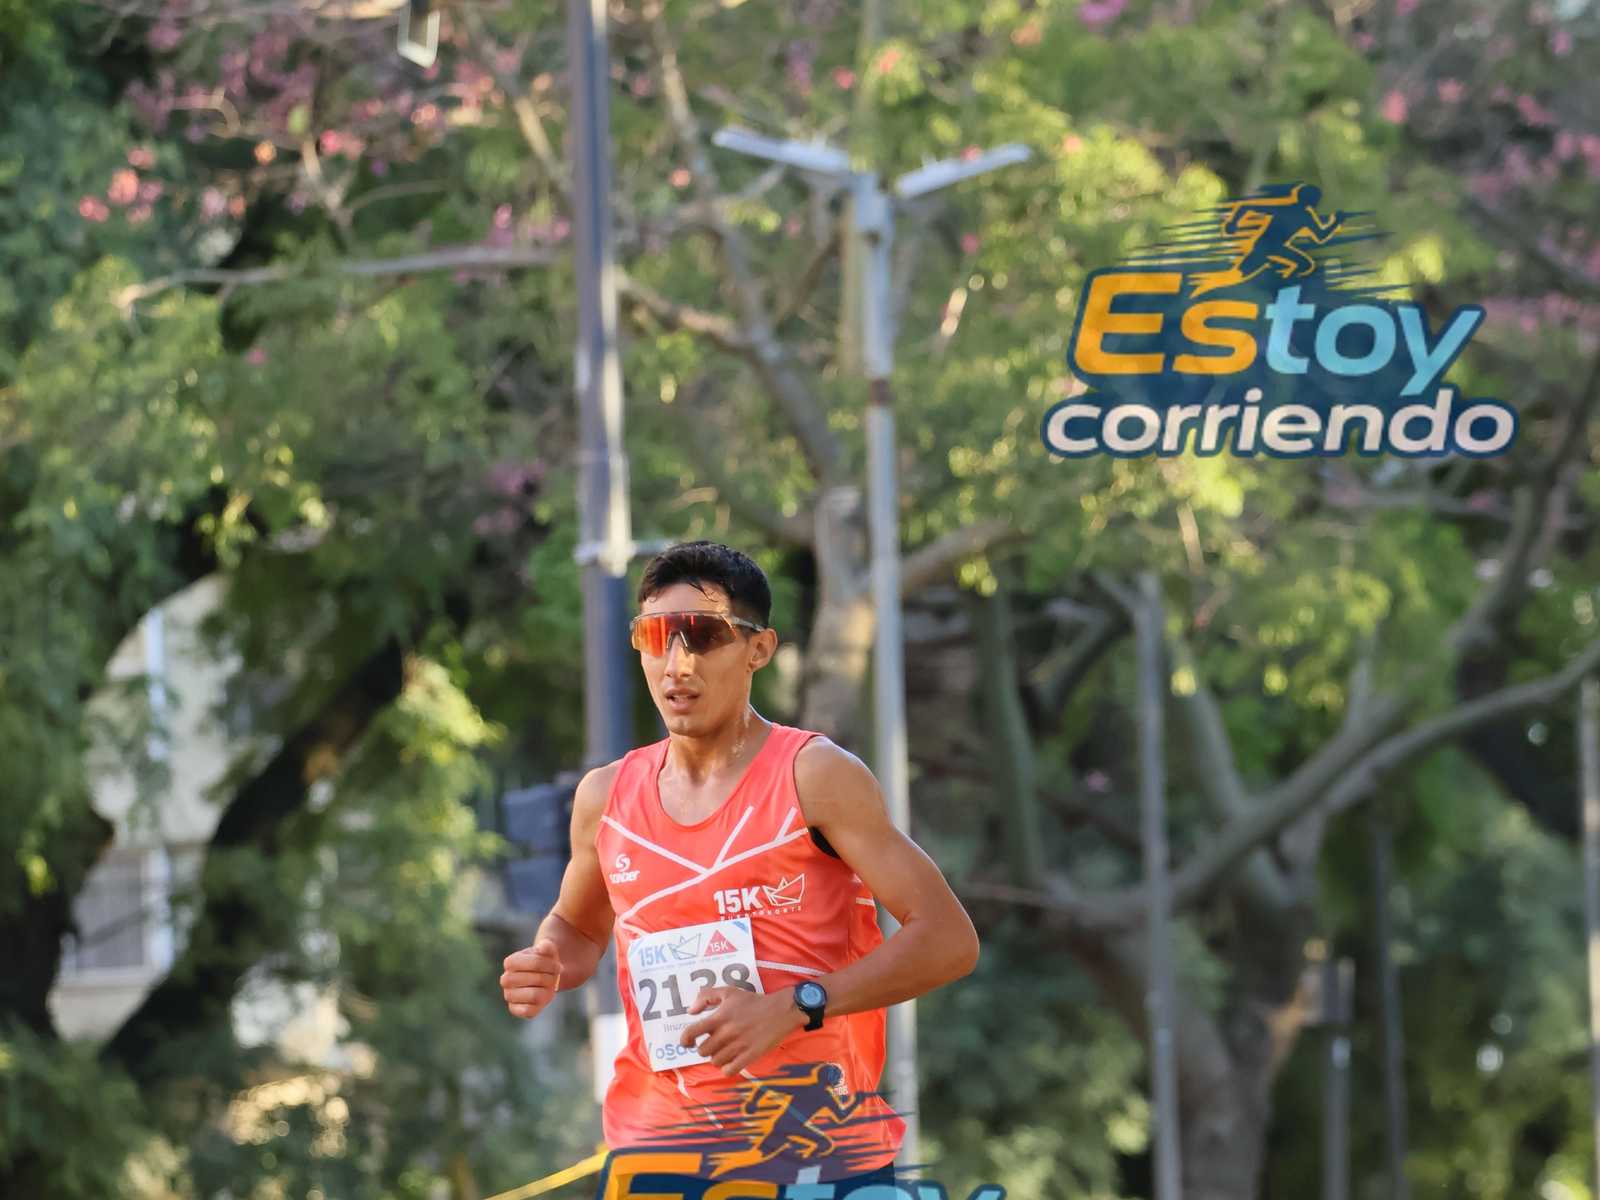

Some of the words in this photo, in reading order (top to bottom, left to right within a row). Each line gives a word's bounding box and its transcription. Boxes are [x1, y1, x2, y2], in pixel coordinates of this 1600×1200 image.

[713, 886, 763, 914] 15K
[639, 943, 668, 967] 15K
[655, 1043, 698, 1060] os
